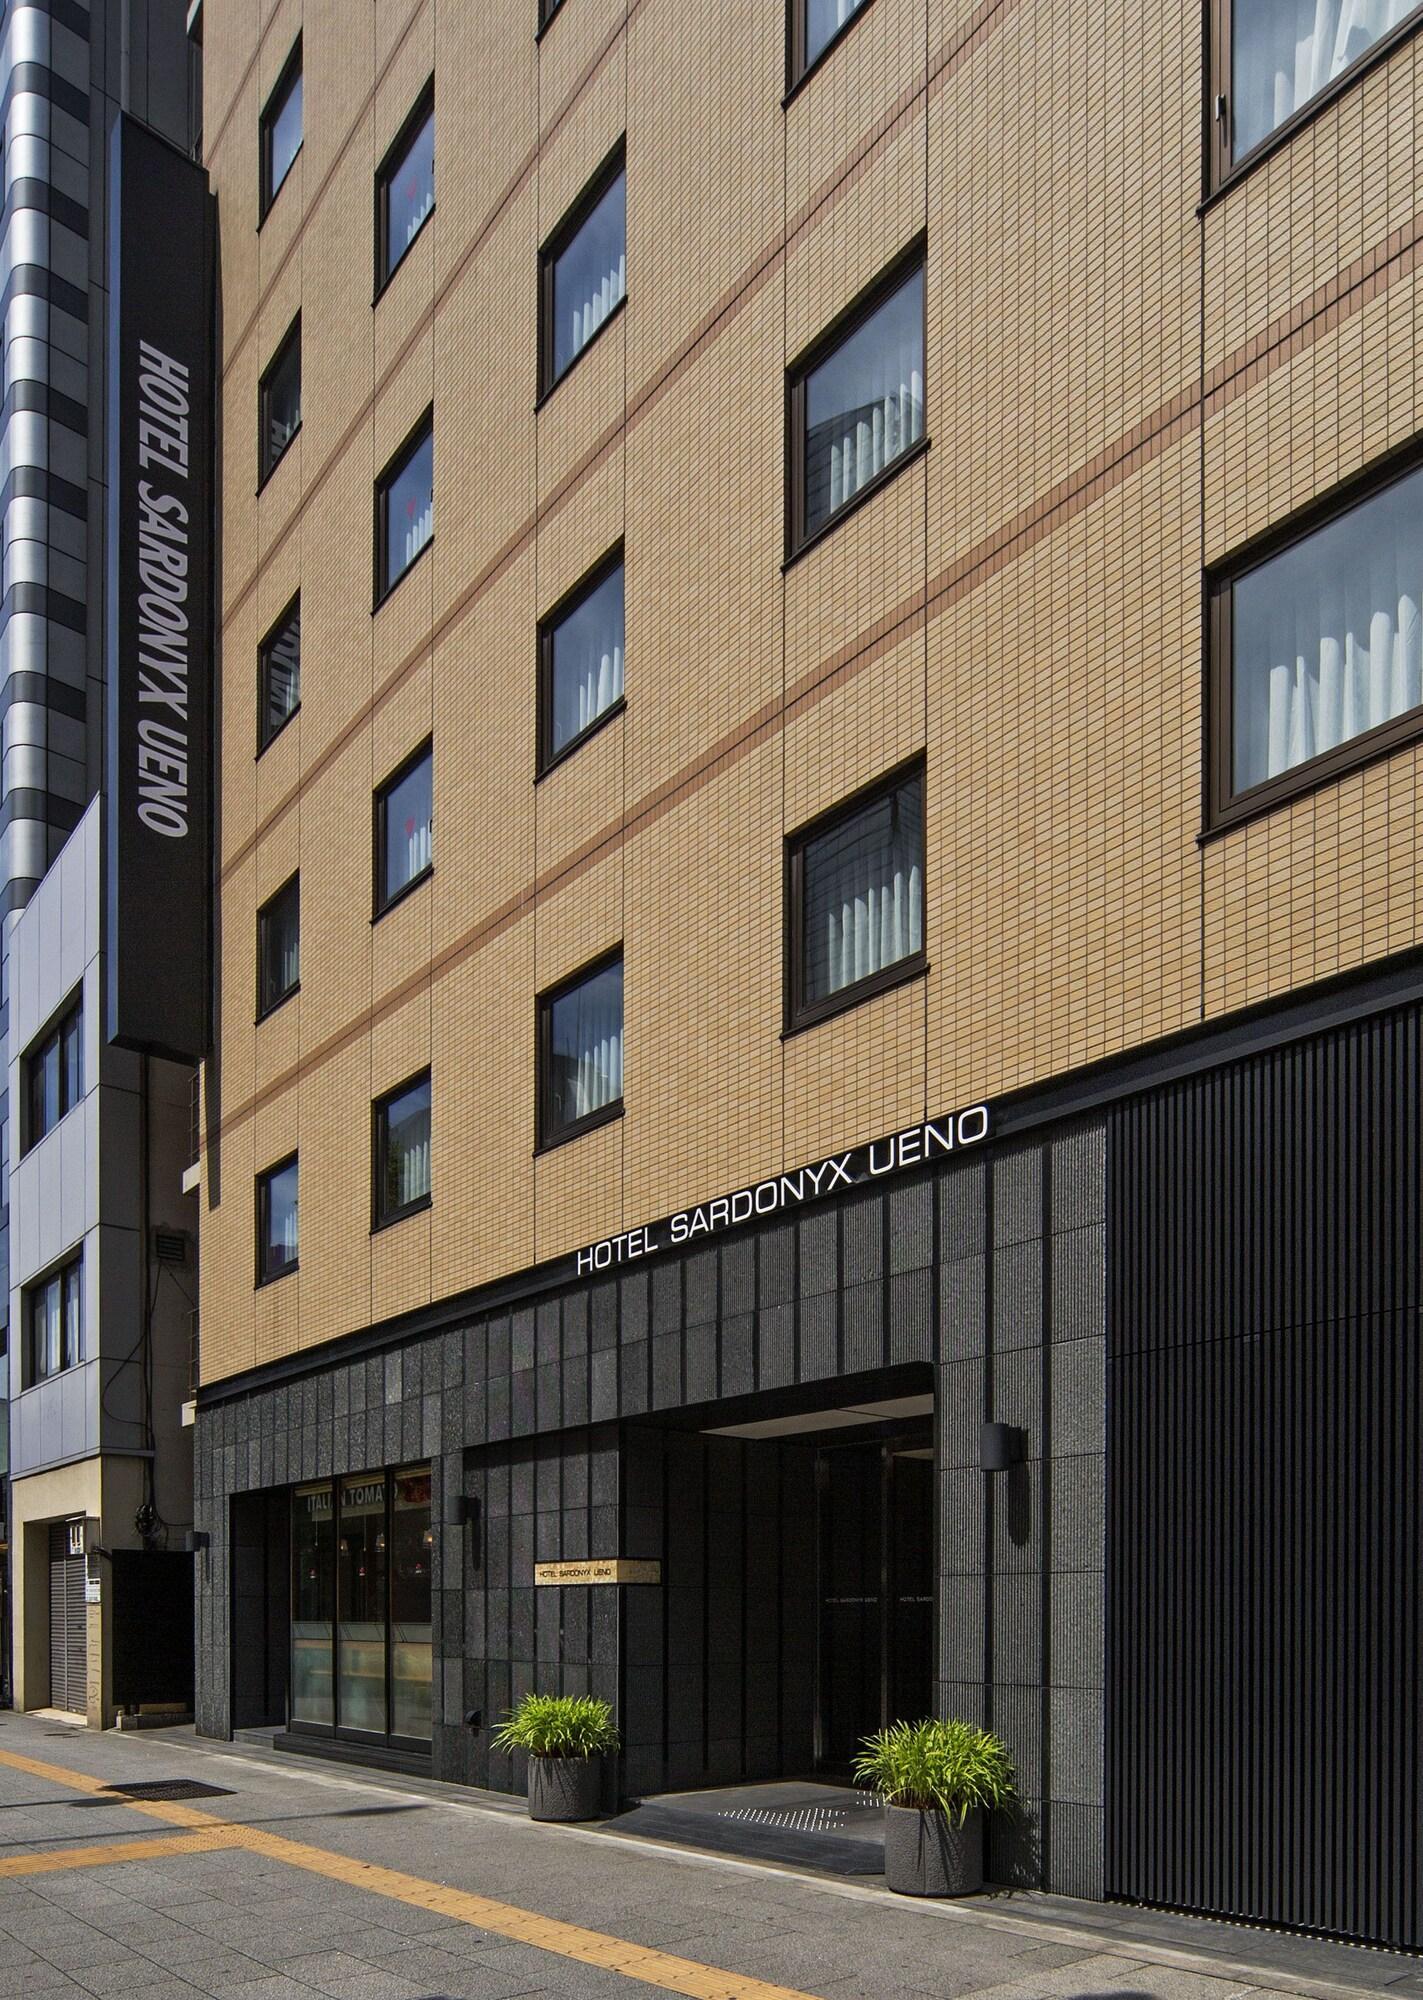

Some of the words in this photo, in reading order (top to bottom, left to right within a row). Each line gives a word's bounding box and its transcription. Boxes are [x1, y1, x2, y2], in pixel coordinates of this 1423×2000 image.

[139, 339, 190, 478] HOTEL
[138, 480, 190, 720] SARDONYX
[138, 717, 190, 838] UENO
[577, 1226, 659, 1276] HOTEL
[670, 1153, 853, 1244] SARDONYX
[869, 1105, 989, 1175] UENO
[307, 1489, 347, 1513] ITALIN
